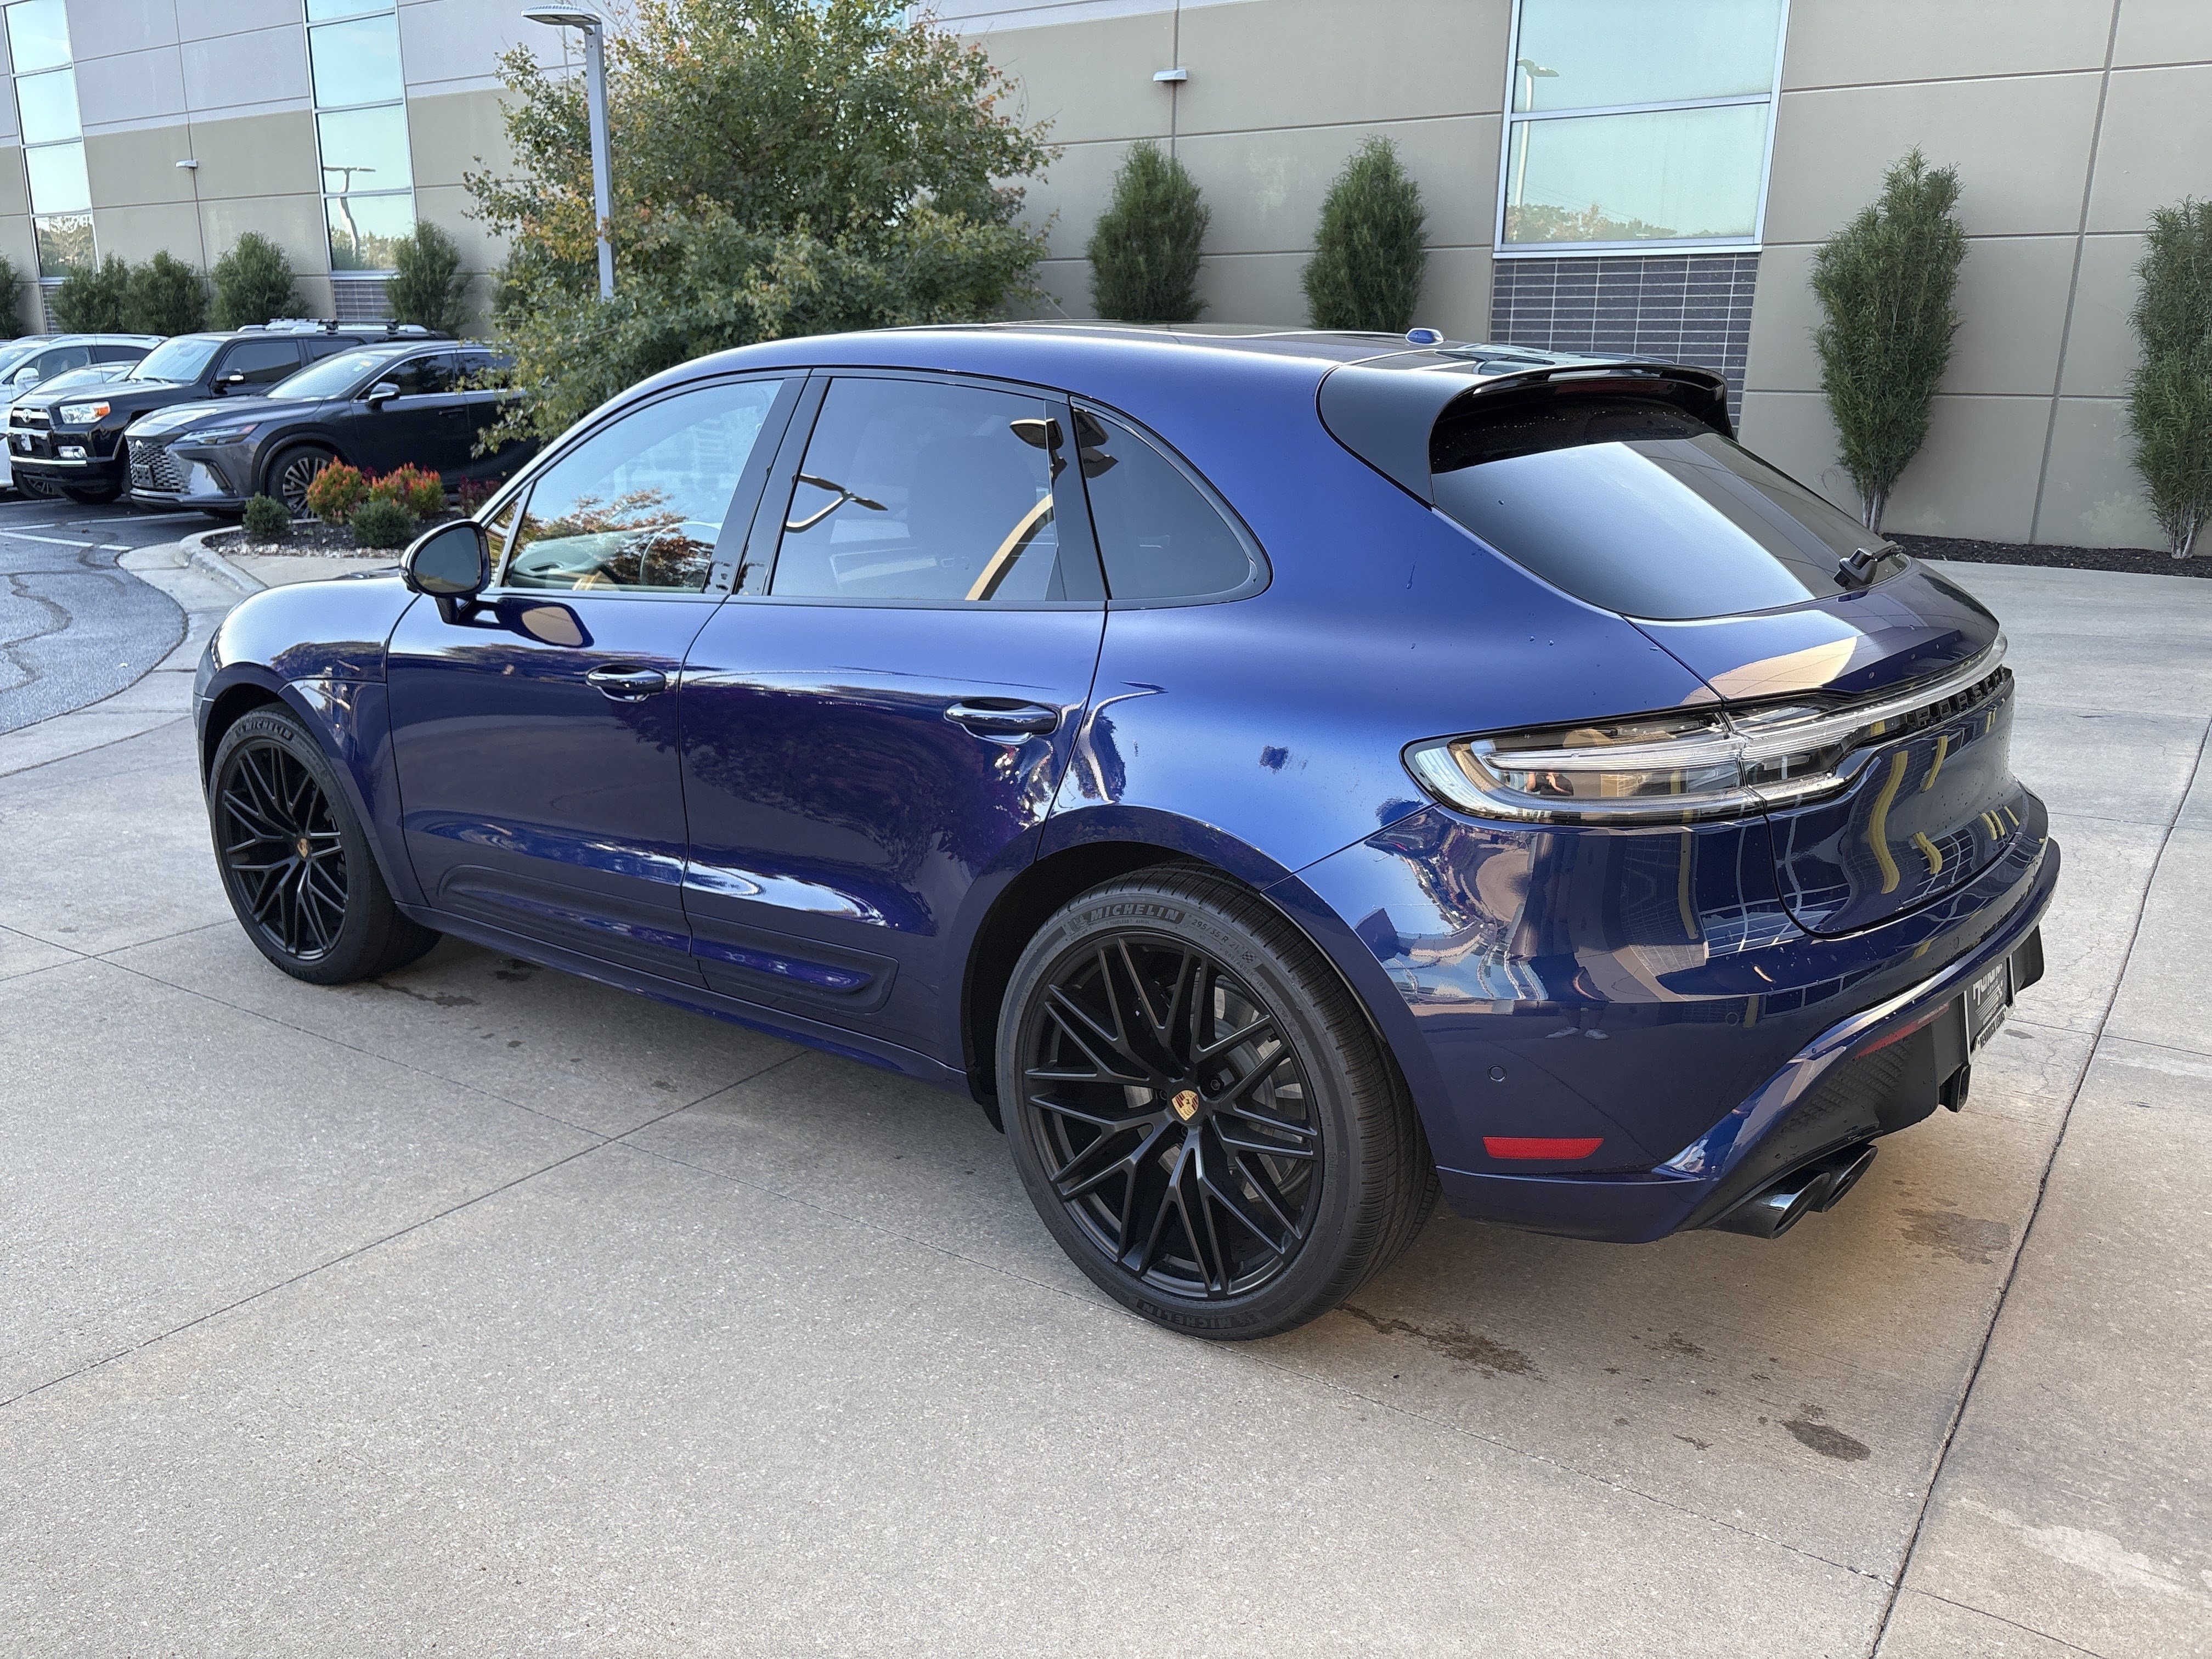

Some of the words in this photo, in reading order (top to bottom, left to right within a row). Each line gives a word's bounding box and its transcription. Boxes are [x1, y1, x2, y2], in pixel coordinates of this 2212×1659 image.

[1915, 666, 2005, 727] PORSCH
[245, 720, 292, 740] MICHELIN
[1090, 904, 1180, 922] MICHELIN
[1191, 918, 1220, 938] 295/35
[1221, 935, 1229, 943] R
[1142, 1302, 1233, 1328] MICHELIN
